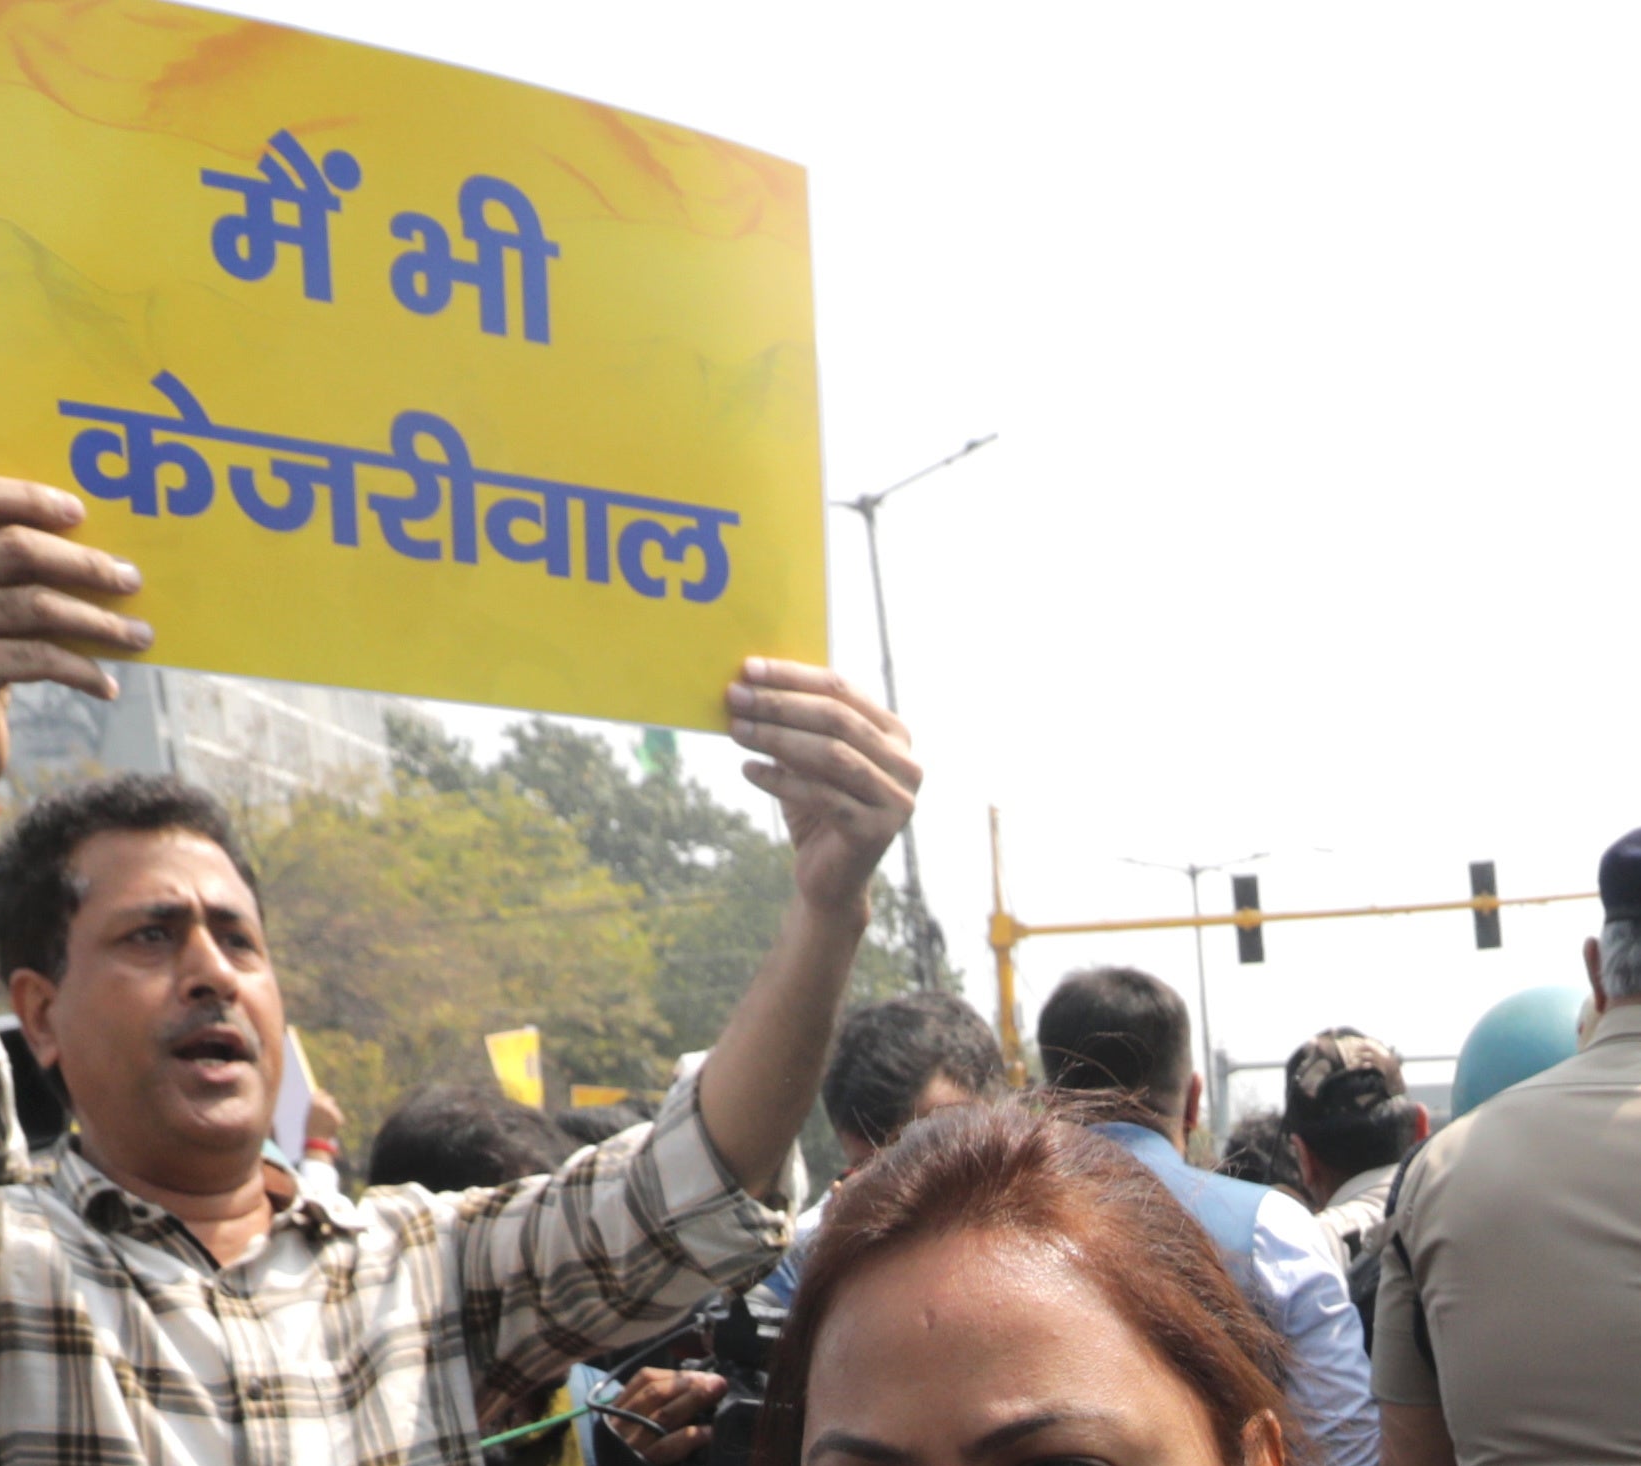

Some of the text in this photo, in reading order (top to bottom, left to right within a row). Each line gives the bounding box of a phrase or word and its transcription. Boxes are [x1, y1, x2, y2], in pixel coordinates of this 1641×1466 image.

[199, 128, 560, 345] मैं भी
[57, 368, 740, 604] केजरीवाल
